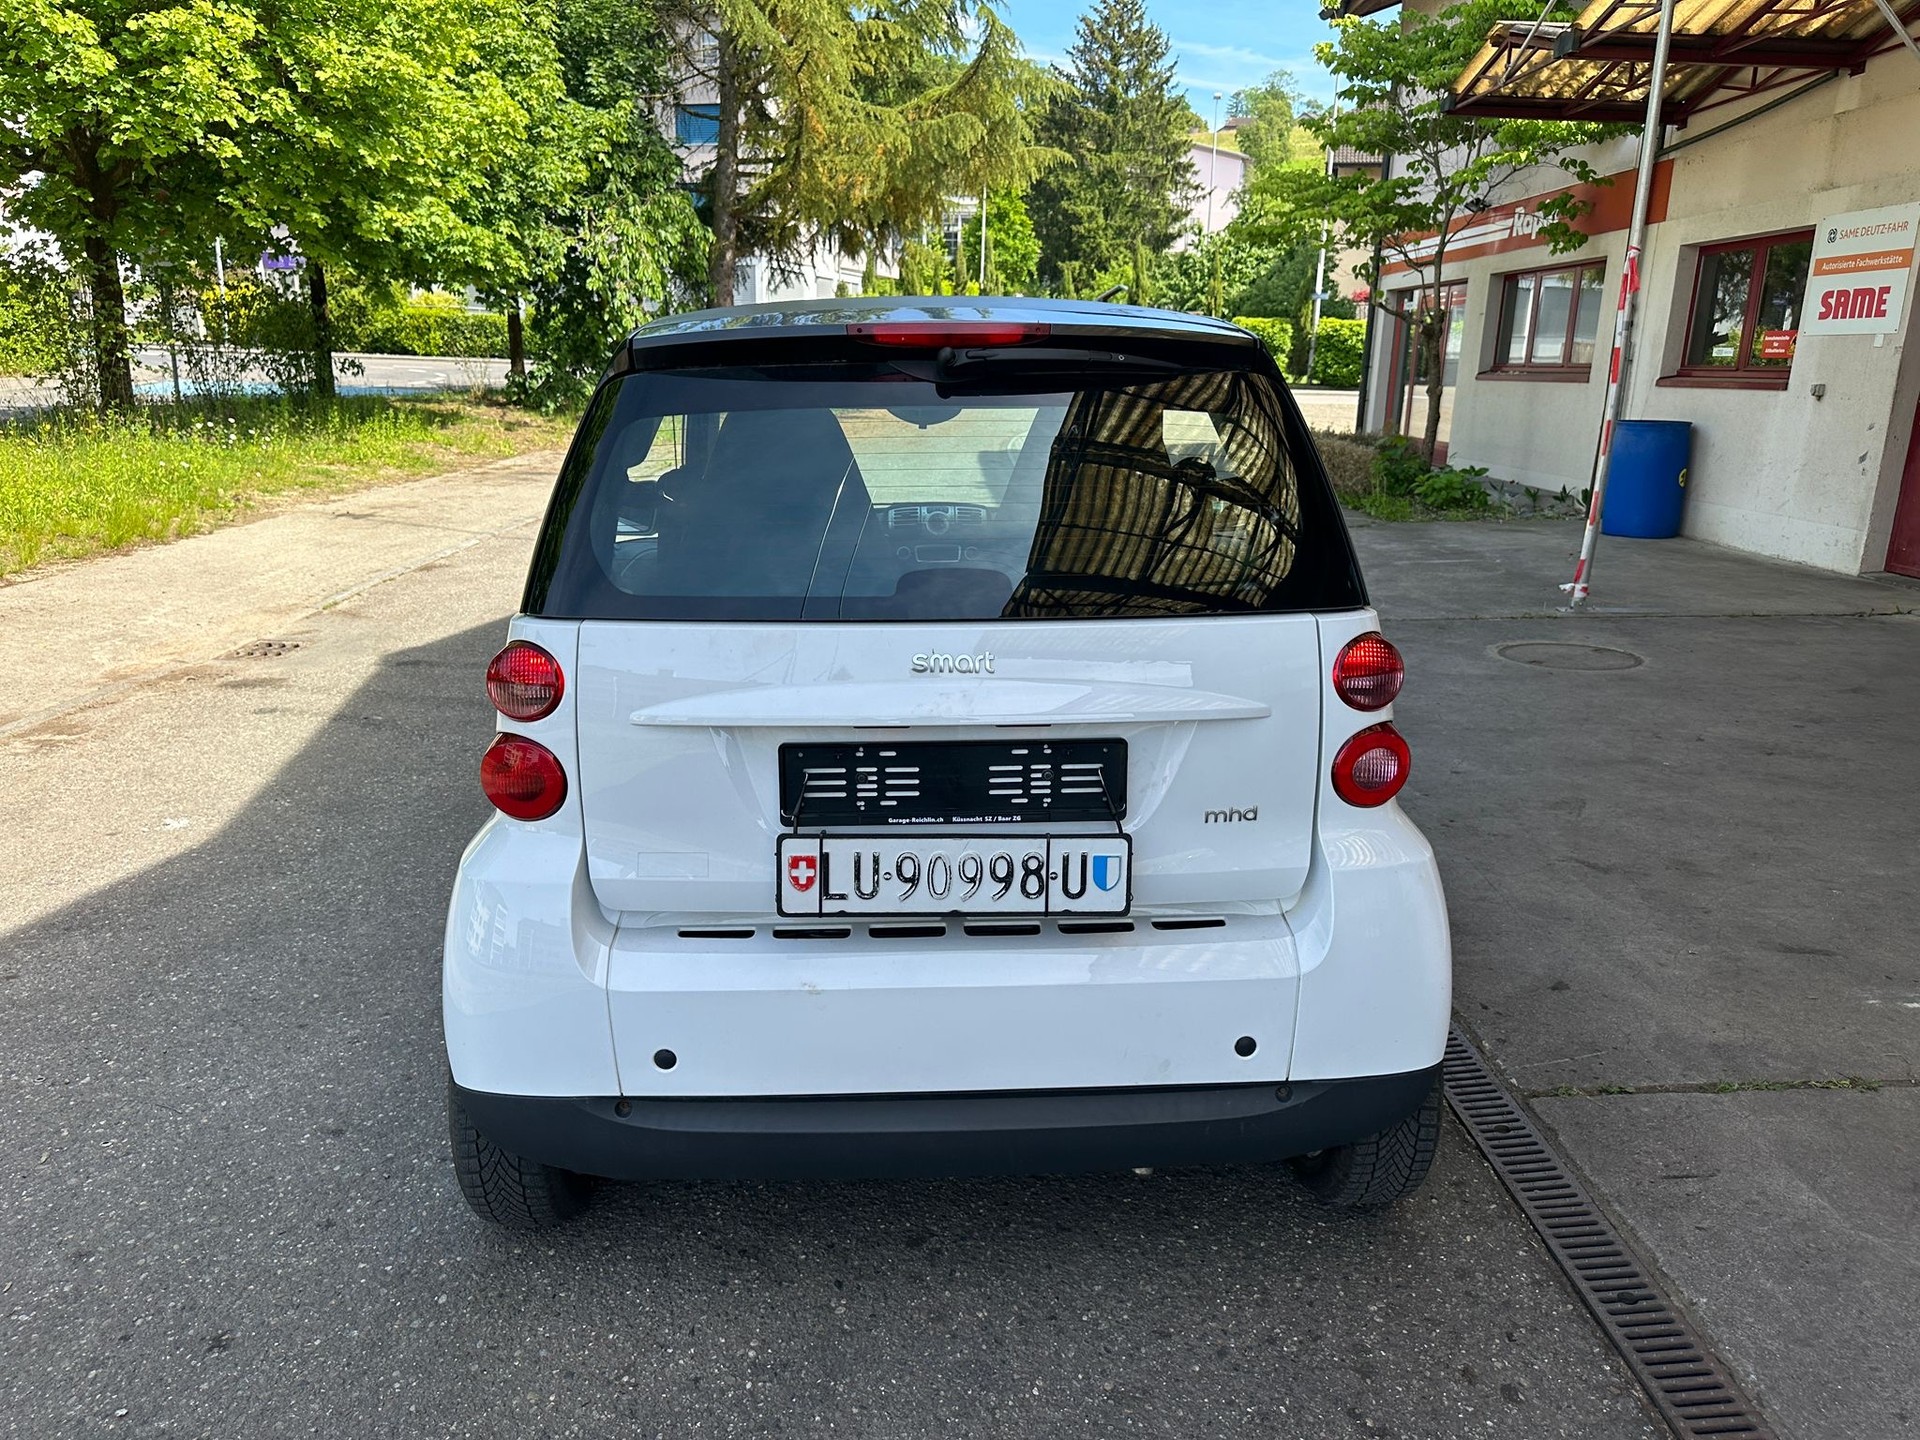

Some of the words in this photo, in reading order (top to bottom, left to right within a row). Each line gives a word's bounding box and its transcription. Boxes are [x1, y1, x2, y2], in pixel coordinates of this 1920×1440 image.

[1839, 226, 1861, 240] SAME
[1861, 220, 1909, 237] DEUTZ-FAHR
[1822, 259, 1856, 271] Autorisierte
[1856, 254, 1903, 267] Fachwerkstätte
[1818, 286, 1892, 321] SAME
[911, 650, 995, 674] smart
[1204, 805, 1258, 824] mhd
